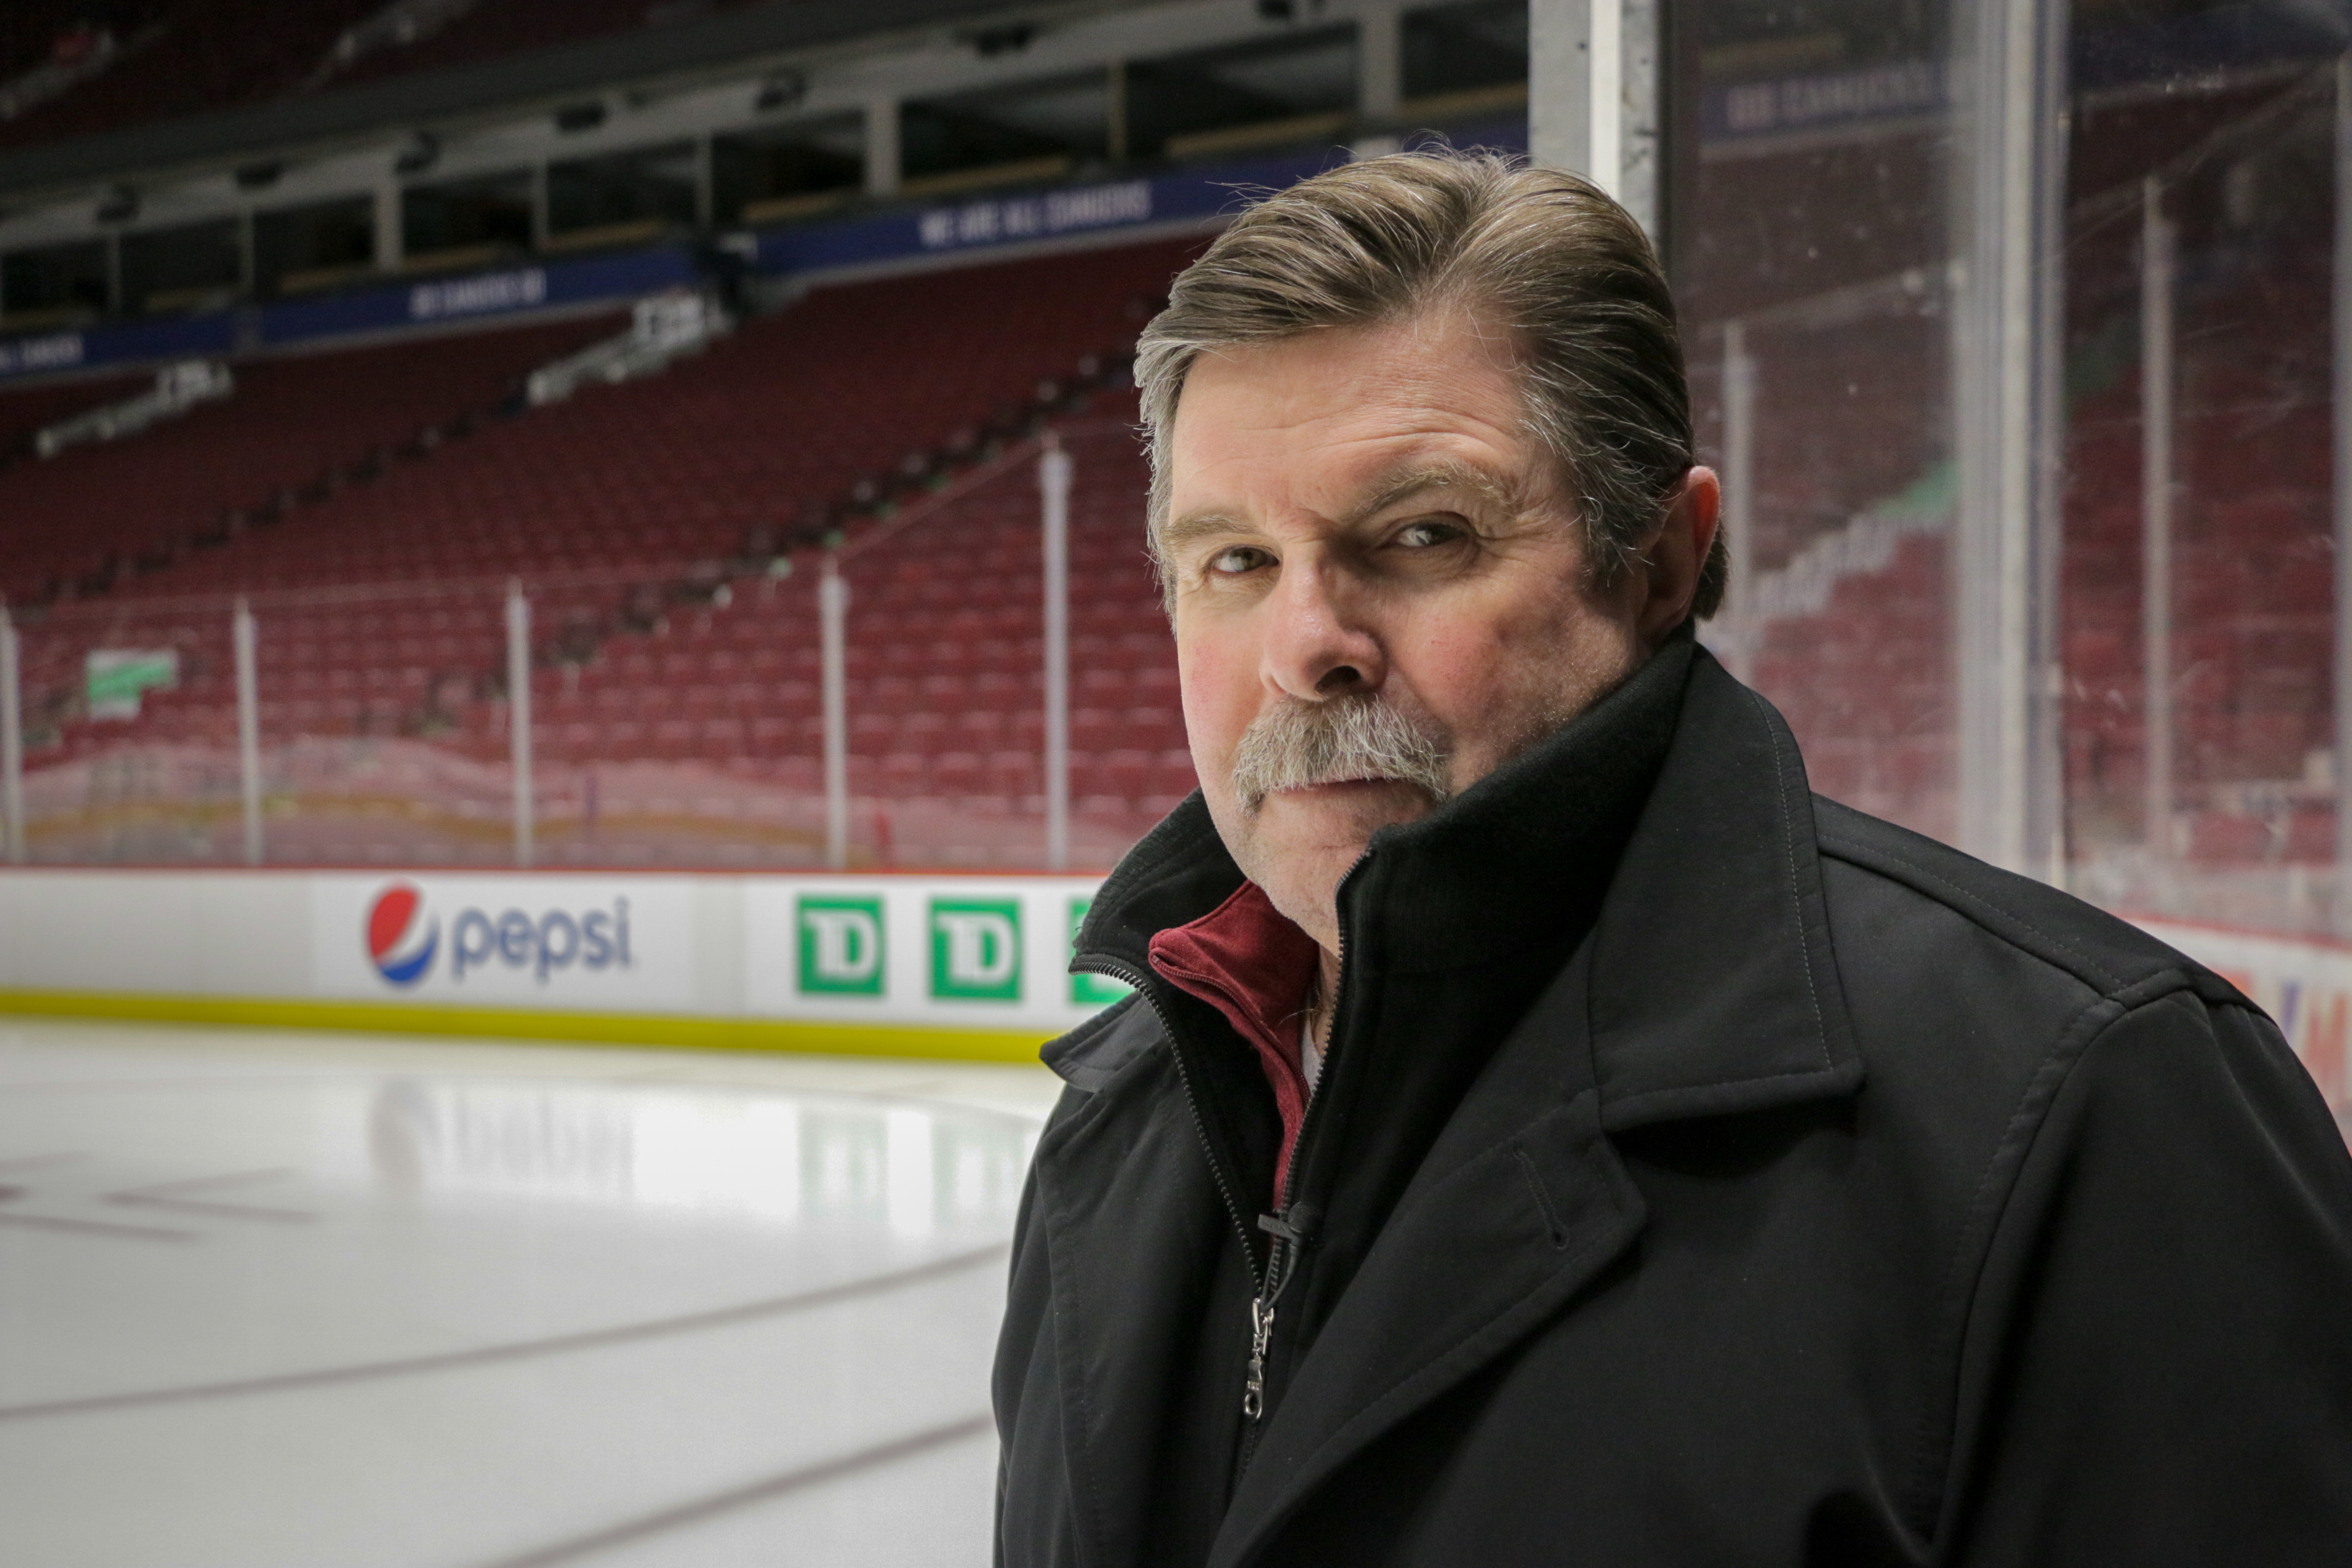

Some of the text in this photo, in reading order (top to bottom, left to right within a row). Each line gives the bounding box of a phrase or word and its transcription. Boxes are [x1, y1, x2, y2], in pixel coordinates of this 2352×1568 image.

[450, 894, 633, 985] pepsi
[802, 909, 879, 980] TD
[935, 913, 1014, 984] TD
